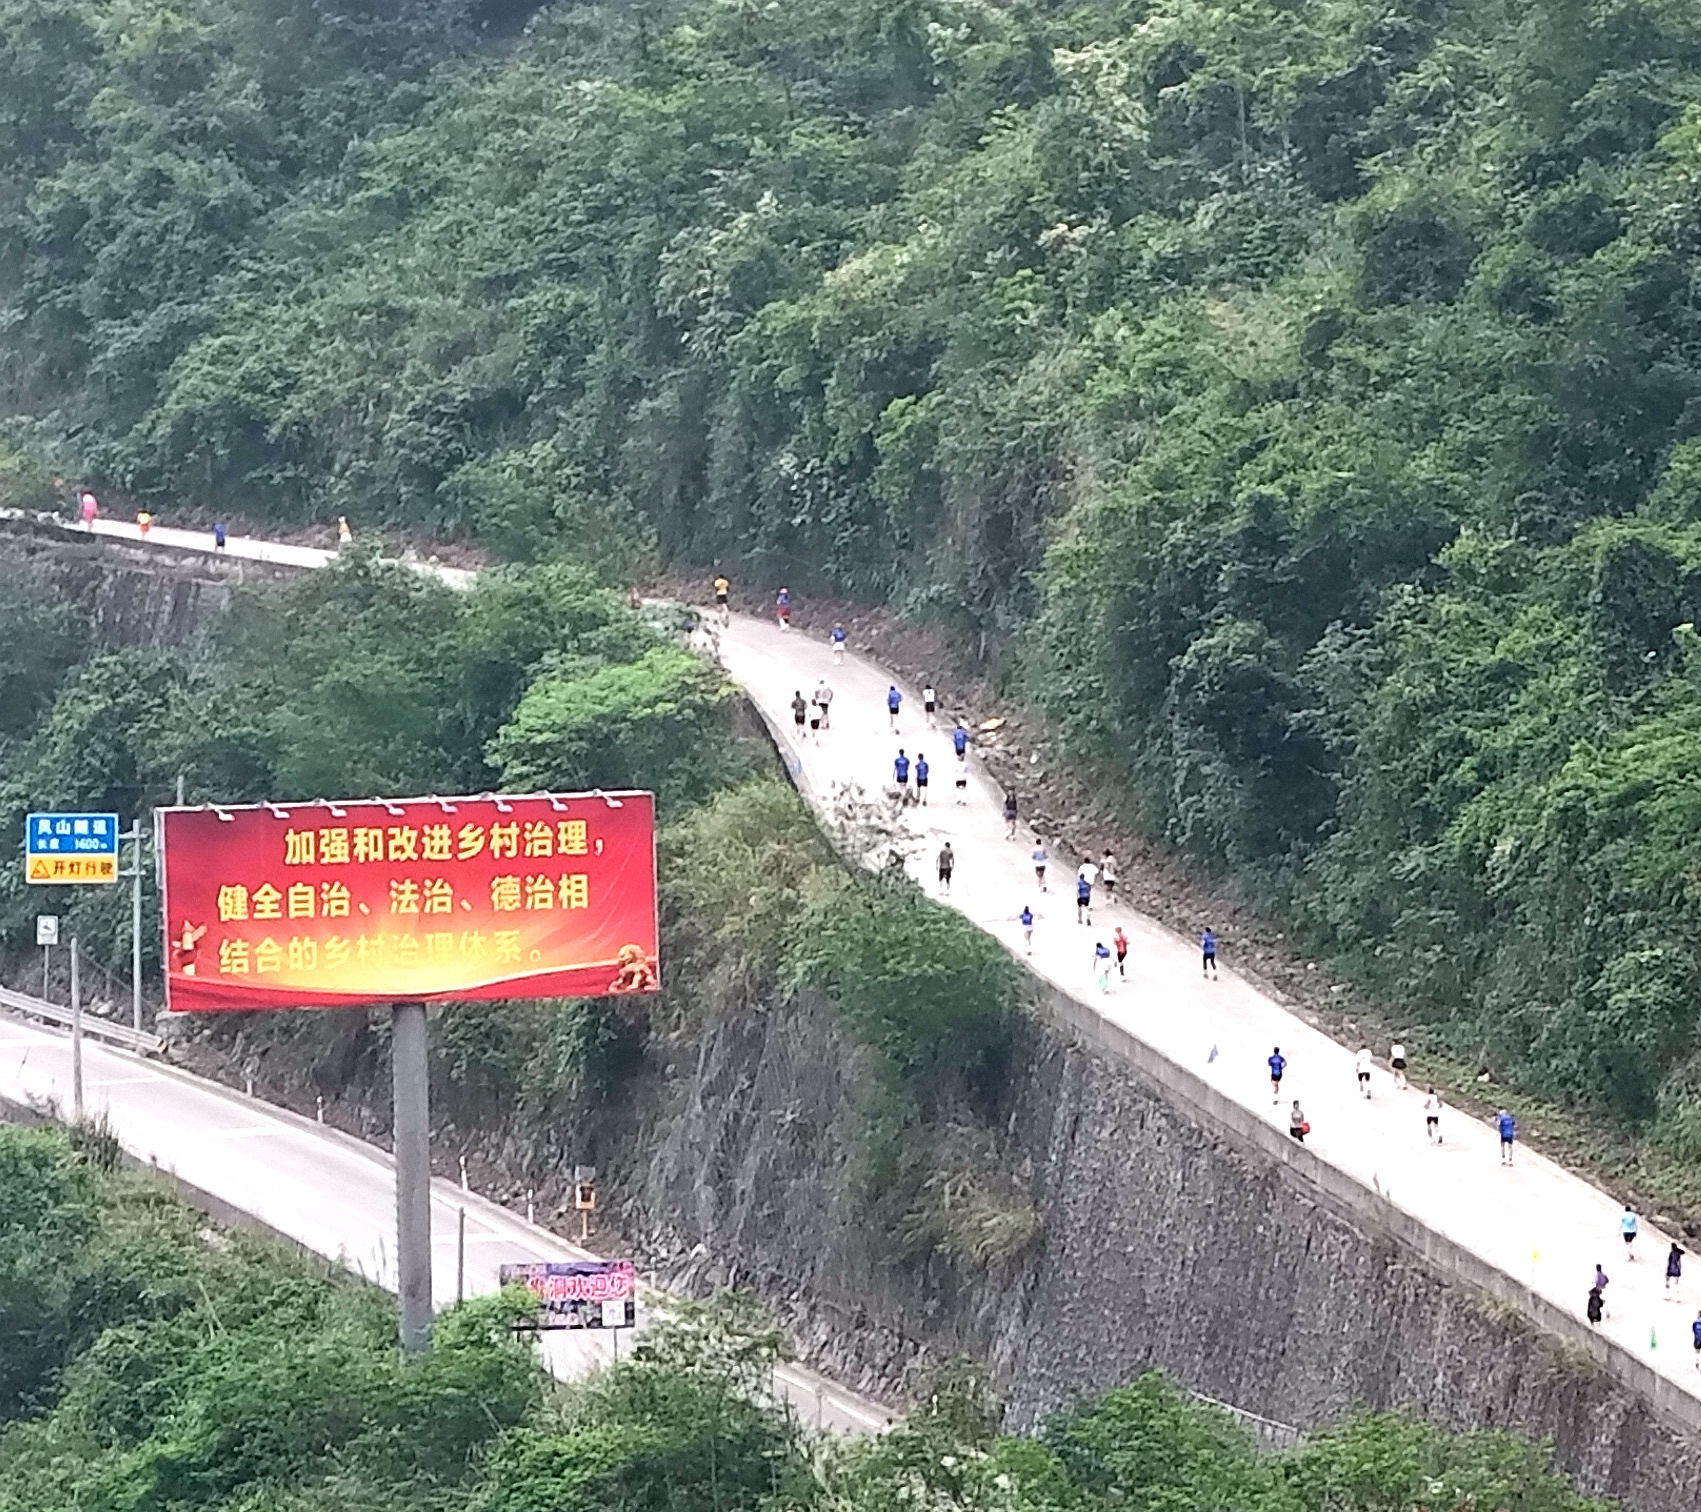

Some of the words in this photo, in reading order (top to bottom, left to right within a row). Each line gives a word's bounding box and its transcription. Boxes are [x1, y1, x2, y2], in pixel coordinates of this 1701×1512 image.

[284, 819, 606, 866] 加强和改进乡村治理，
[53, 860, 113, 876] 开灯行驶
[217, 873, 590, 922] 健全自治、法治、德治相
[218, 929, 542, 976] 结合的乡村治理体系。
